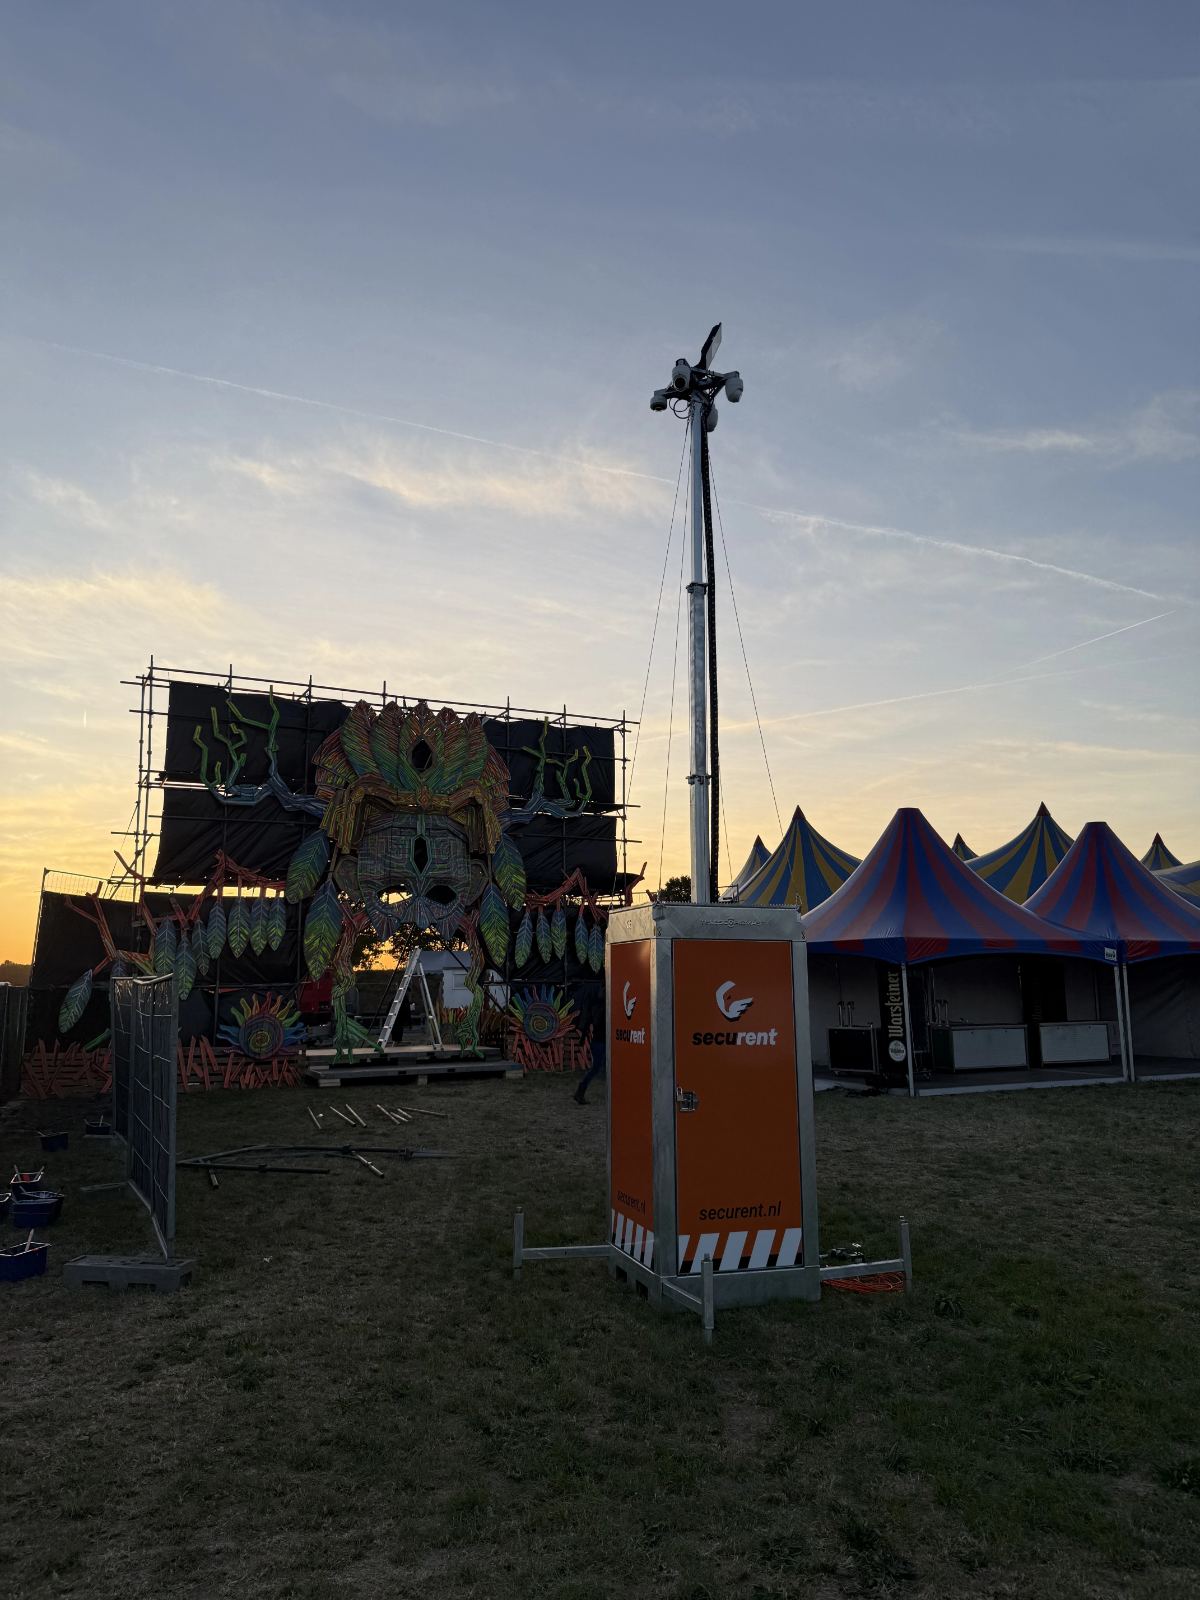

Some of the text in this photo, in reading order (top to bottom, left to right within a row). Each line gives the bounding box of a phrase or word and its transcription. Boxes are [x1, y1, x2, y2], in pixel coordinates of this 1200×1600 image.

[884, 970, 904, 1039] Warsteiner
[692, 1028, 778, 1046] securent
[699, 1200, 782, 1221] securent.nl
